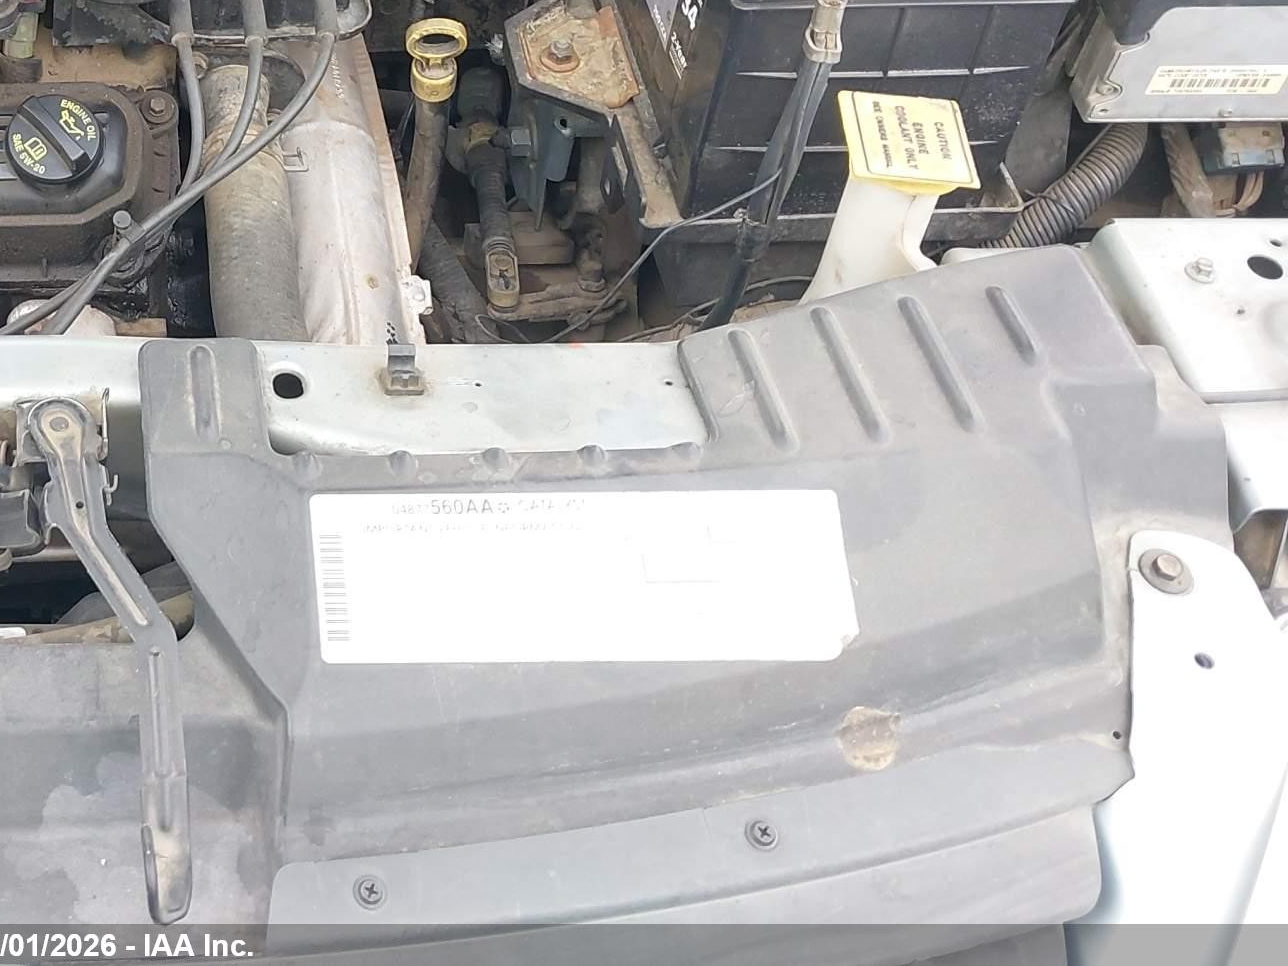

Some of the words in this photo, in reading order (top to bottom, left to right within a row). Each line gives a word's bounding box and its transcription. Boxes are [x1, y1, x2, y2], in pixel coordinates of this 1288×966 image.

[59, 98, 91, 127] ENGINE
[85, 125, 97, 142] OIL
[894, 105, 914, 144] COOLANT
[904, 146, 920, 171] ONLY
[12, 133, 25, 154] SAE
[911, 122, 930, 155] ENGINE
[933, 121, 953, 161] CAUTION
[18, 151, 47, 175] 5W-20
